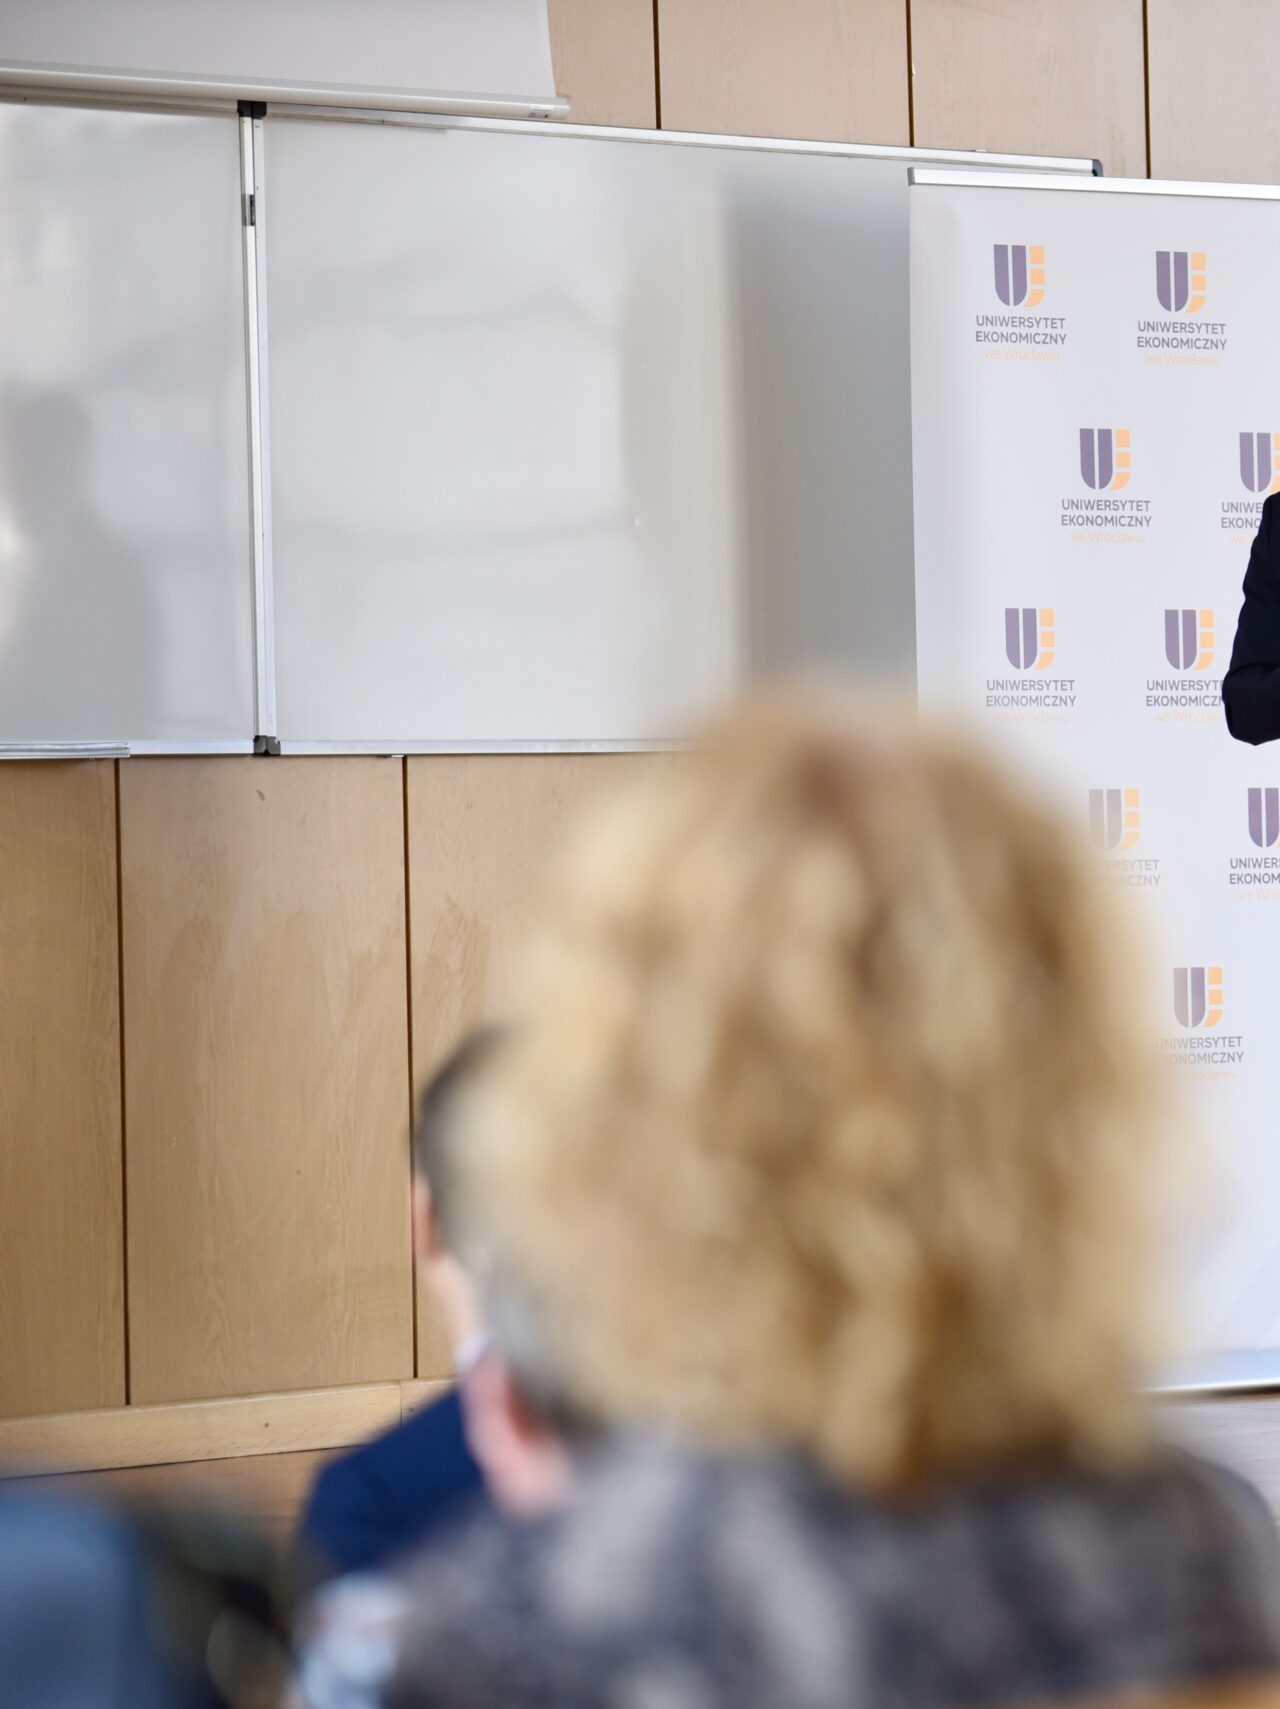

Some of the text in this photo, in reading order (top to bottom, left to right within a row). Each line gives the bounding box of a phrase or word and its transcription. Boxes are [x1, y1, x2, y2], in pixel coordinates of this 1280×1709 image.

[976, 314, 1066, 330] UNIWERSYTET
[1137, 320, 1227, 335] UNIWERSYTET
[975, 330, 1067, 345] EKONOMICZNY
[1136, 336, 1228, 351] EKONOMICZNY
[1061, 499, 1152, 512] UNIWERSYTET
[1060, 514, 1153, 528] EKONOMICZNY
[986, 679, 1076, 692] UNIWERSYTET
[1146, 680, 1223, 691] UNIWERSYT
[986, 695, 1077, 707] EKONOMICZNY
[1146, 695, 1223, 707] EKONOMICZ
